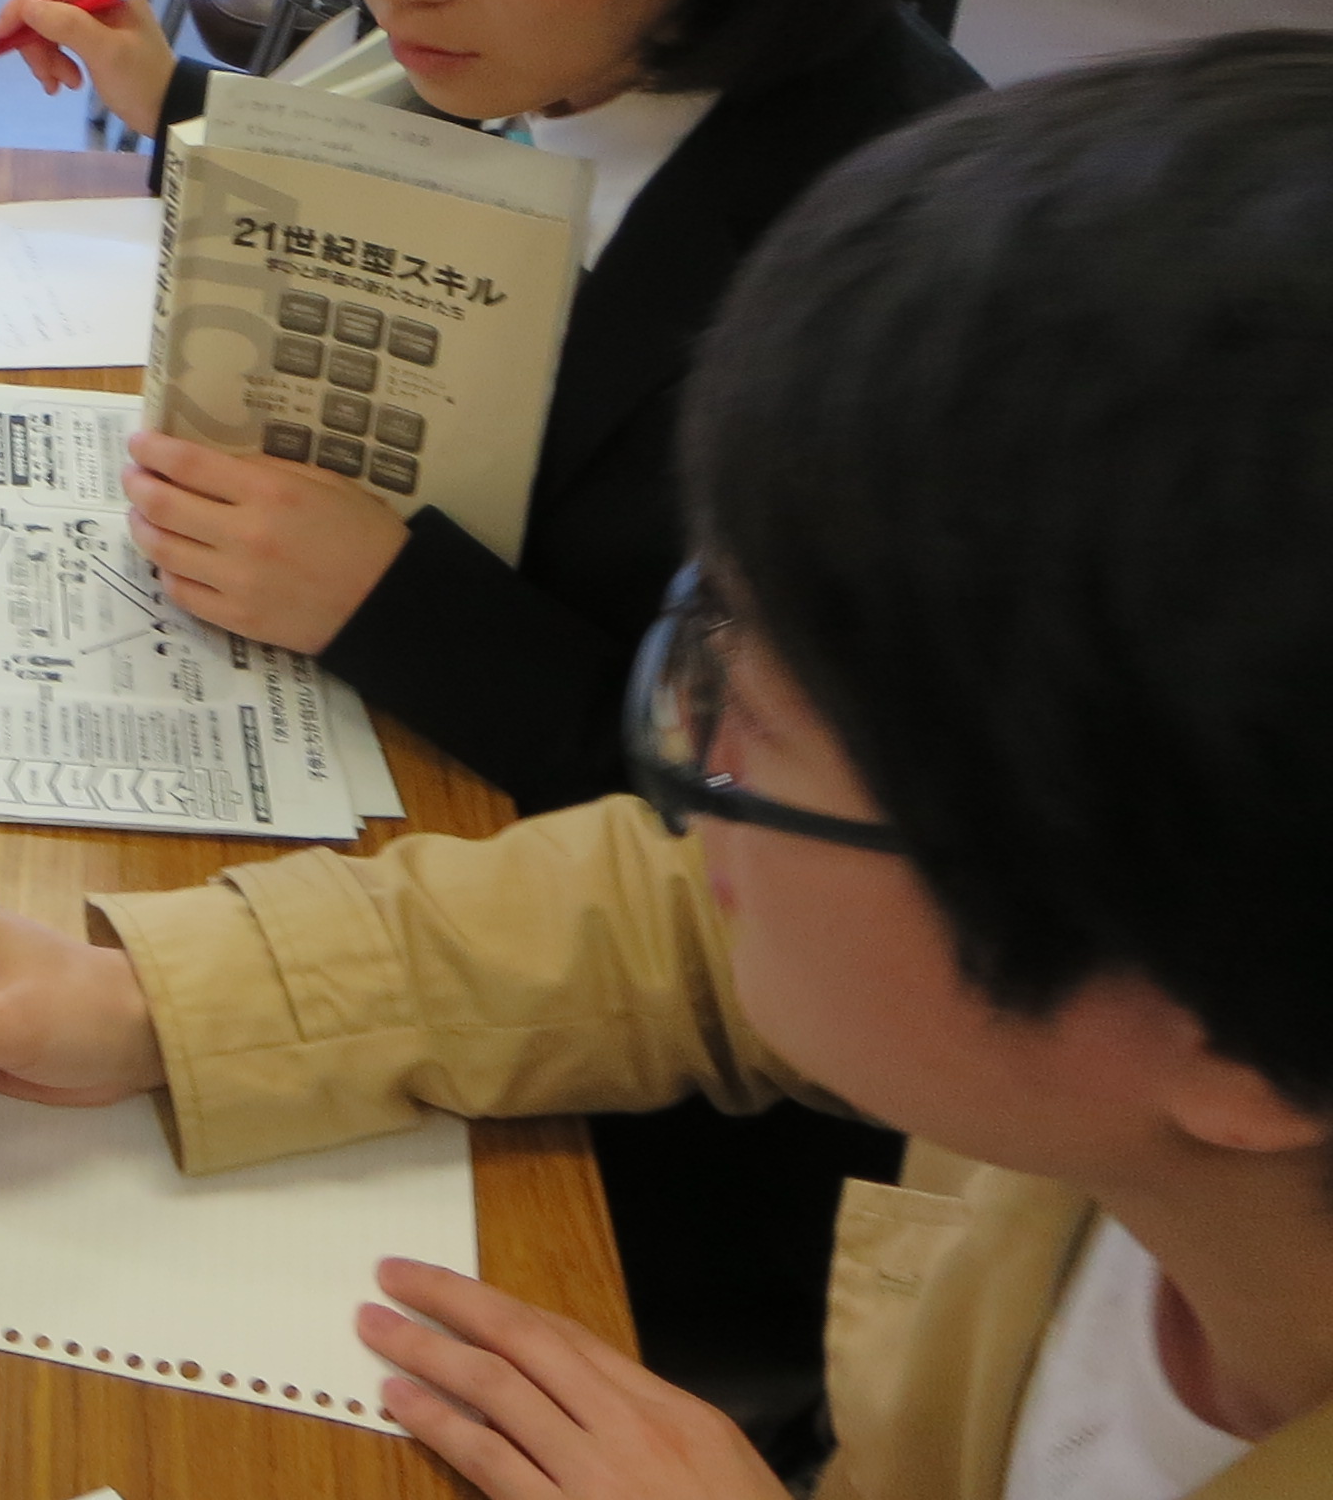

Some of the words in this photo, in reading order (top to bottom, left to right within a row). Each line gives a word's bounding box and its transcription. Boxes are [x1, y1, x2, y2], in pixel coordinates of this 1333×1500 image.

[233, 216, 507, 308] 21世紀型スキル
